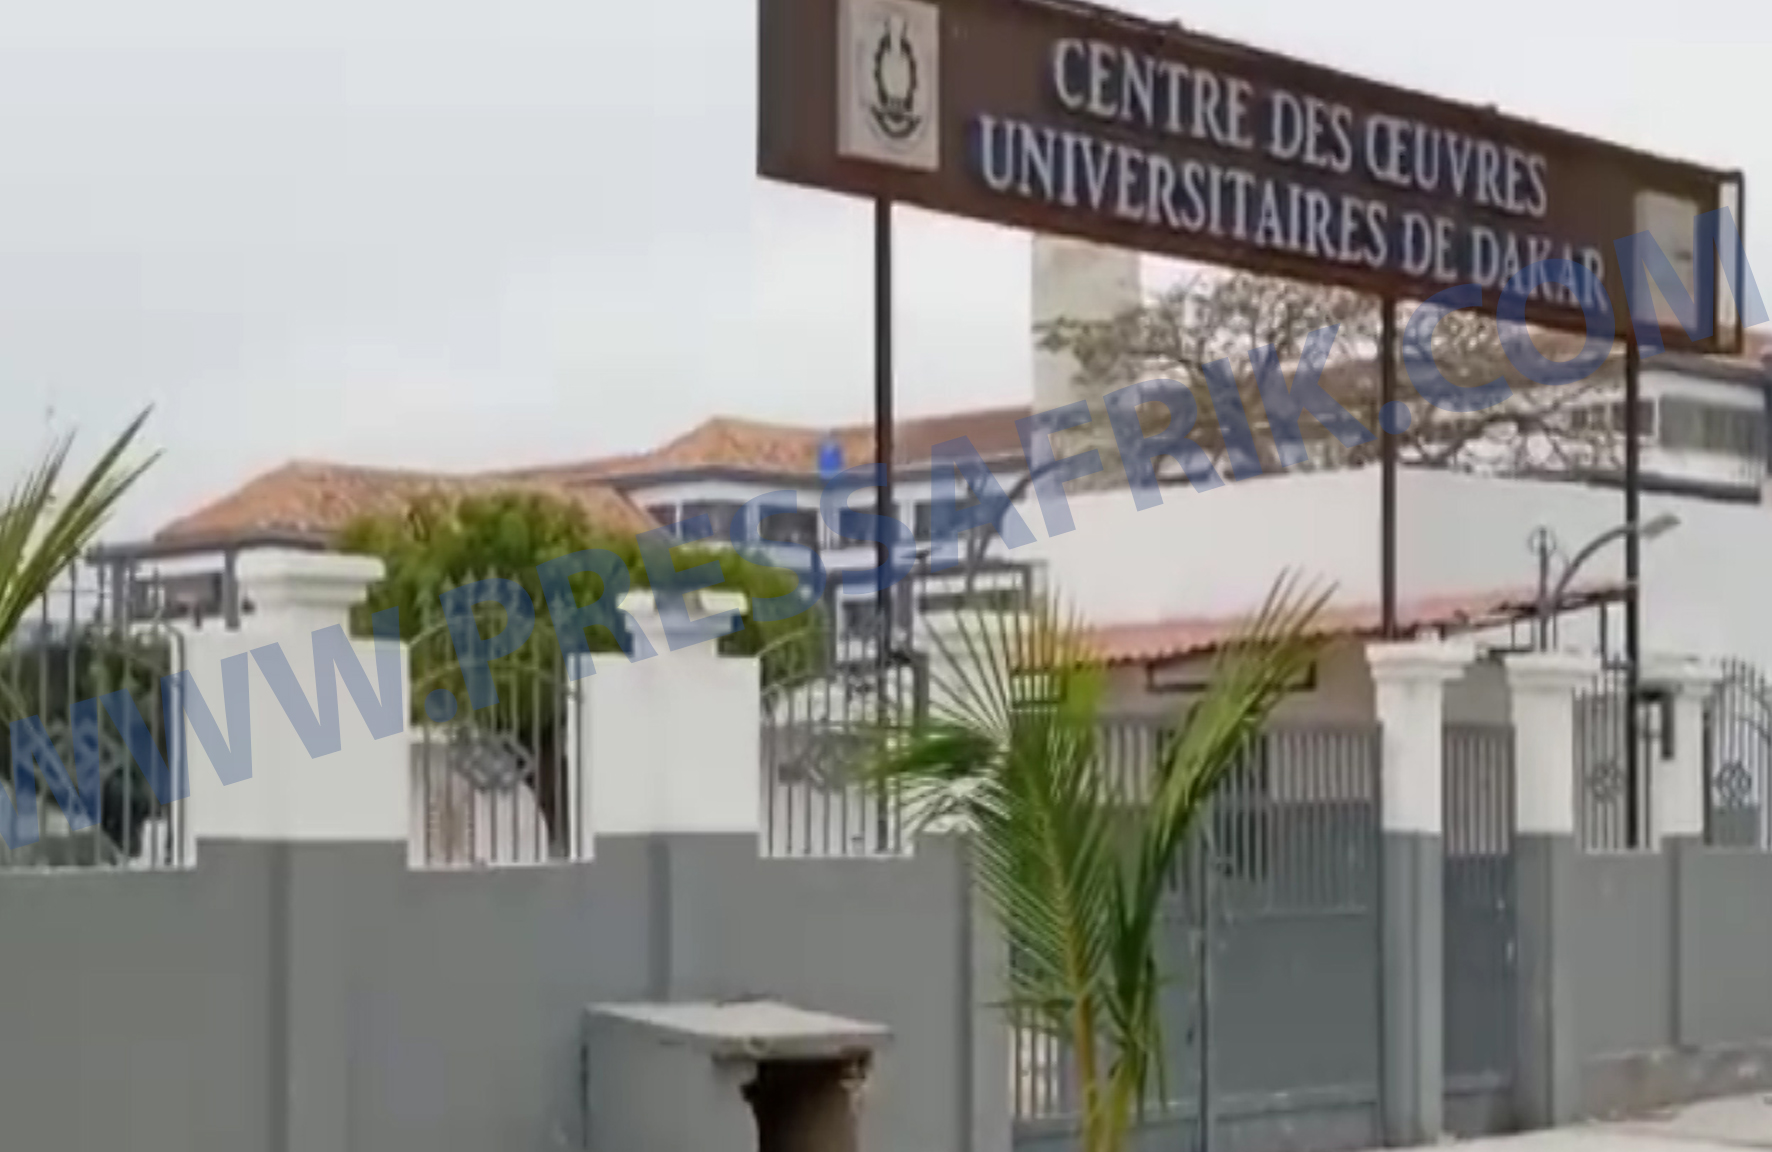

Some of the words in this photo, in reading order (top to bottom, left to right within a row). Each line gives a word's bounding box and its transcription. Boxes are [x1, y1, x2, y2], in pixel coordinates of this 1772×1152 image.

[978, 114, 1389, 269] UNIVERSITAIRES
[1400, 211, 1459, 283] DE
[1471, 225, 1609, 314] DAKAR
[1053, 37, 1255, 149] CENTRE
[1269, 91, 1351, 175] DES
[1365, 113, 1549, 218] ŒUVRES
